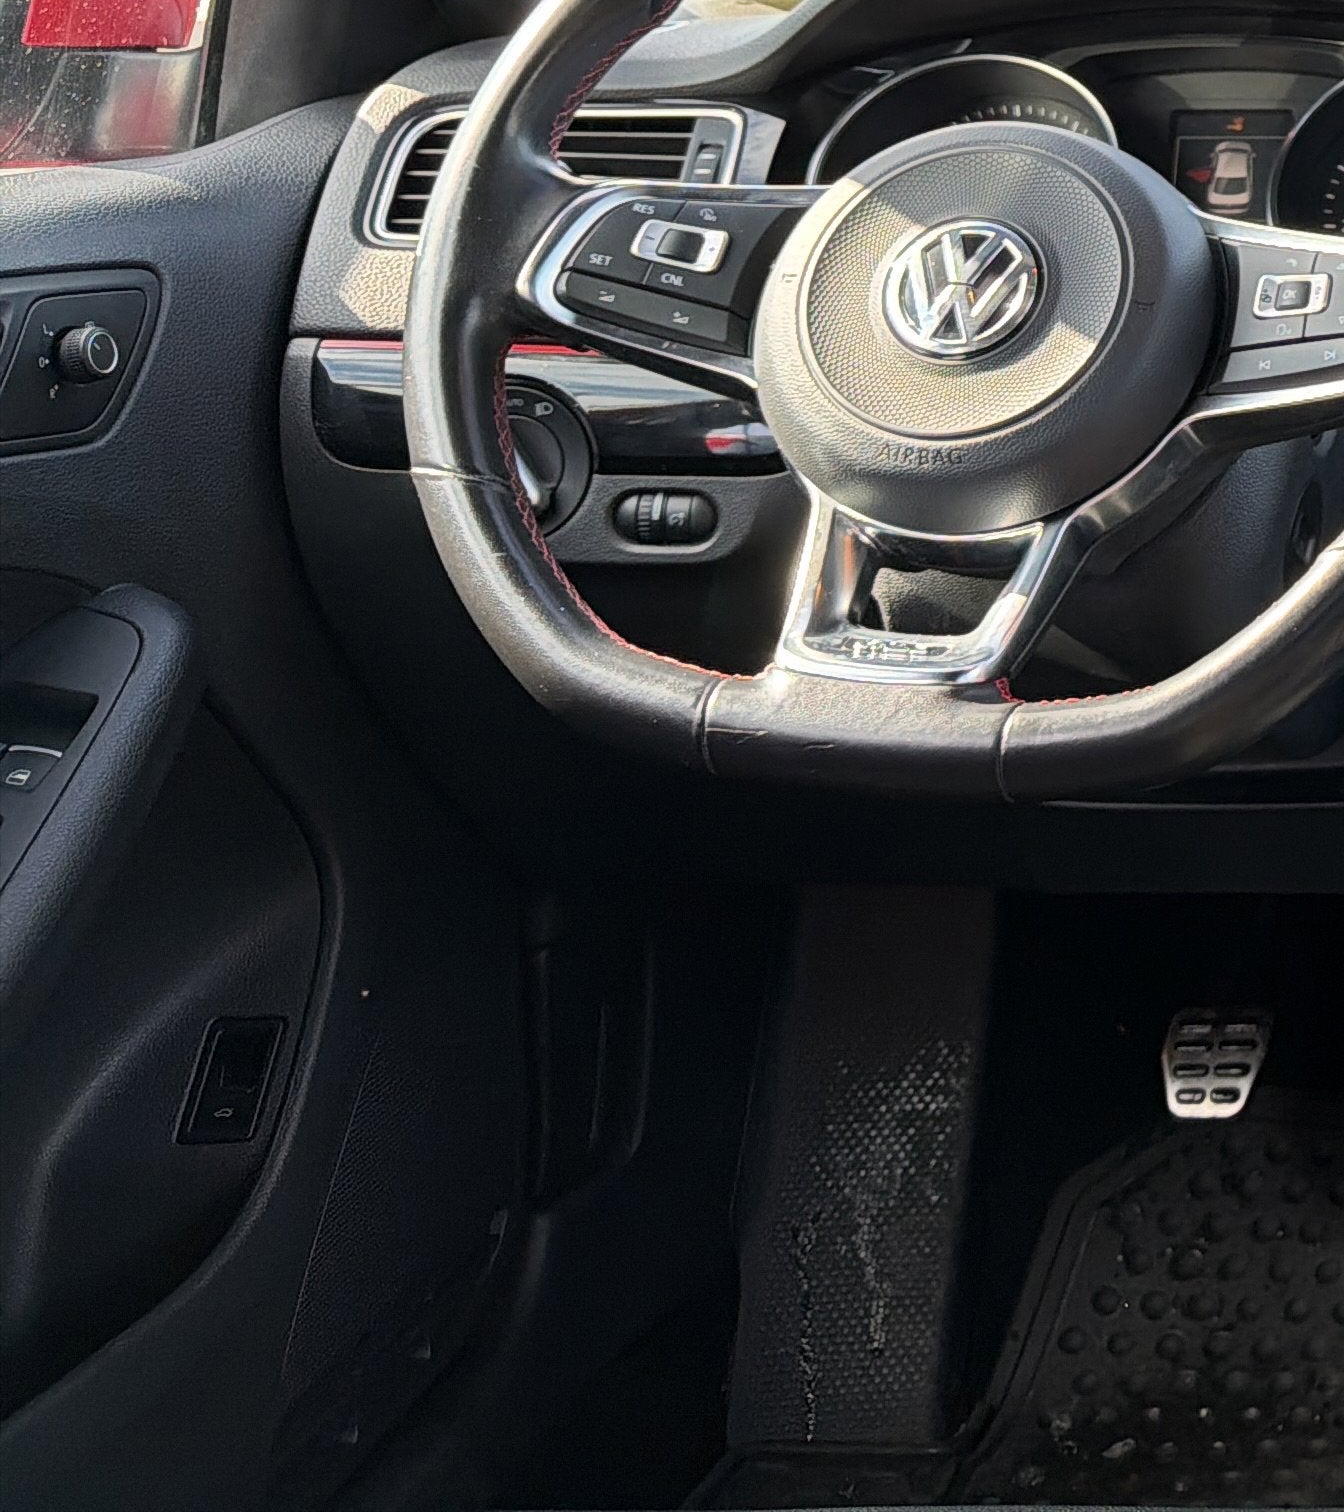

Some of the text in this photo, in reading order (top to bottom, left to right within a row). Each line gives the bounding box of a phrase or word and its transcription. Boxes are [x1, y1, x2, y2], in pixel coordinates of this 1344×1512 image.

[632, 203, 656, 216] RES
[589, 253, 614, 266] SET
[660, 272, 685, 287] CNL
[1282, 289, 1297, 299] OK
[879, 443, 963, 465] AIRBAG
